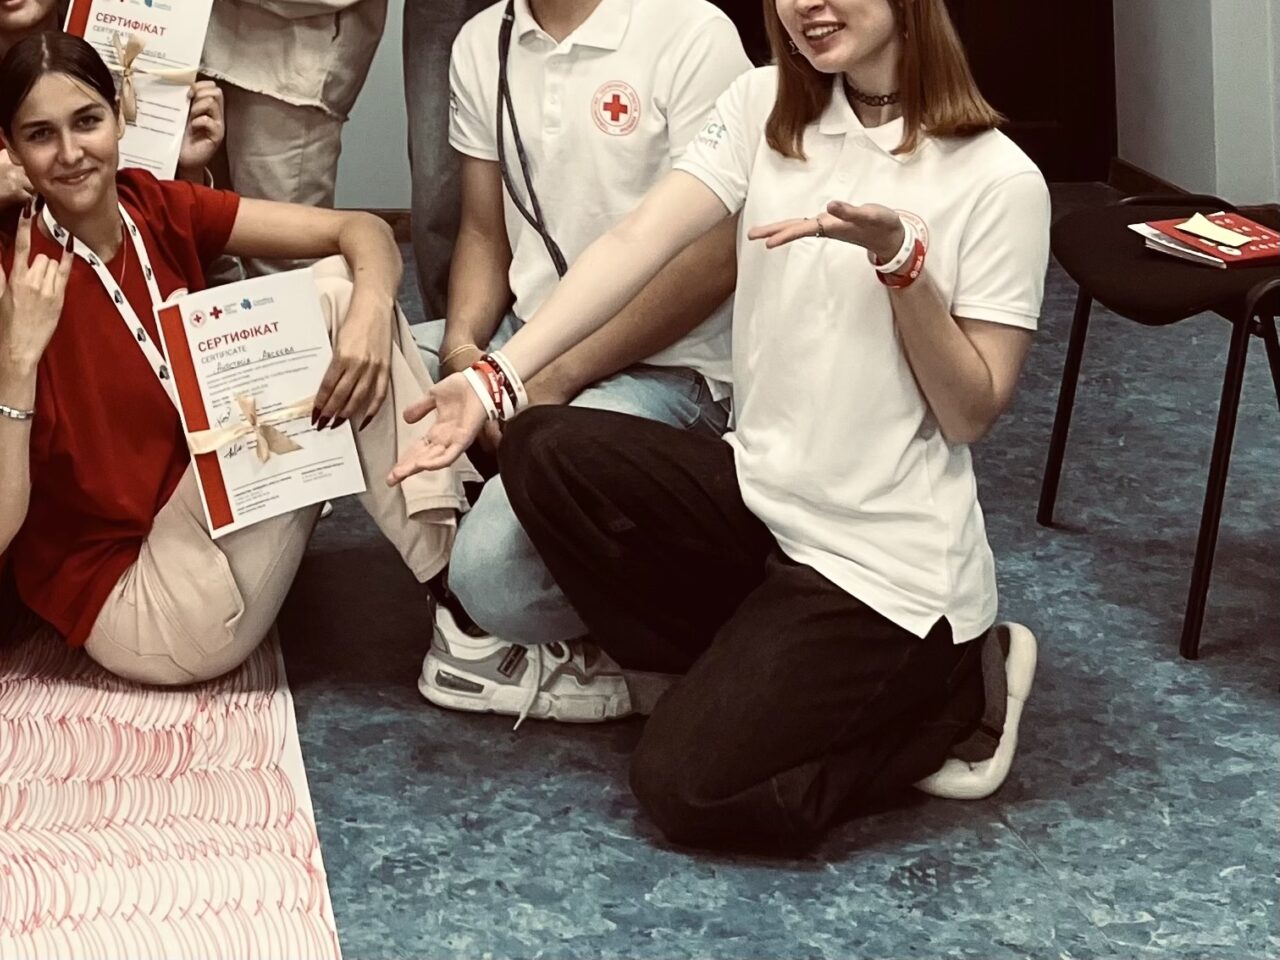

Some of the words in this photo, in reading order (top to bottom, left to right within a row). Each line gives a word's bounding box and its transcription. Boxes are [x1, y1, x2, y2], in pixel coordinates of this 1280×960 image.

[95, 12, 167, 37] СЕРТИФІКАТ
[198, 321, 279, 352] СЕРТИФІКАТ
[200, 346, 247, 365] CERTIFICATE
